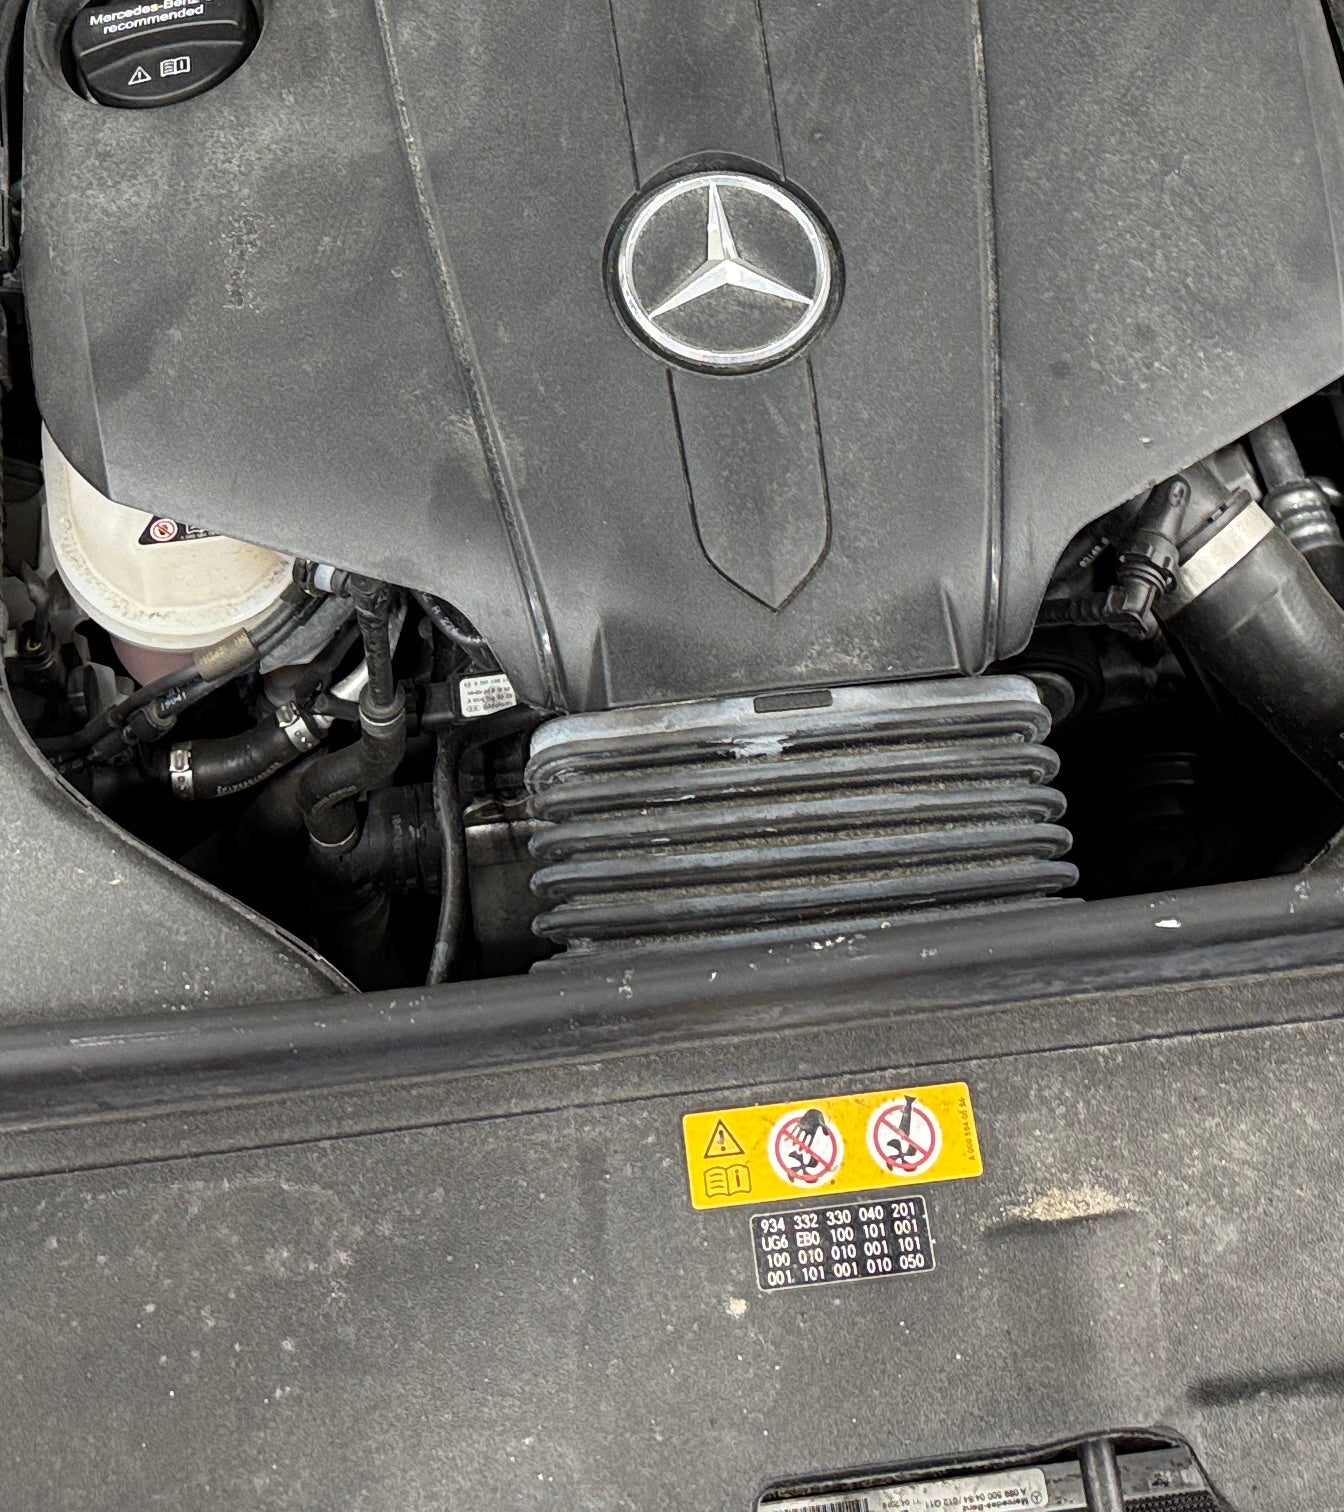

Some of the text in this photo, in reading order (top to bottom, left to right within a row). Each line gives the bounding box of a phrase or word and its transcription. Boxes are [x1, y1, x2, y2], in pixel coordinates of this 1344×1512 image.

[103, 4, 204, 34] recommended
[761, 1202, 916, 1233] 934 332 330 040 201
[761, 1219, 918, 1251] UG6 EB0 100 101 001
[766, 1236, 921, 1269] 100 010 010 001 101
[767, 1253, 925, 1286] 001 101 001 010 050
